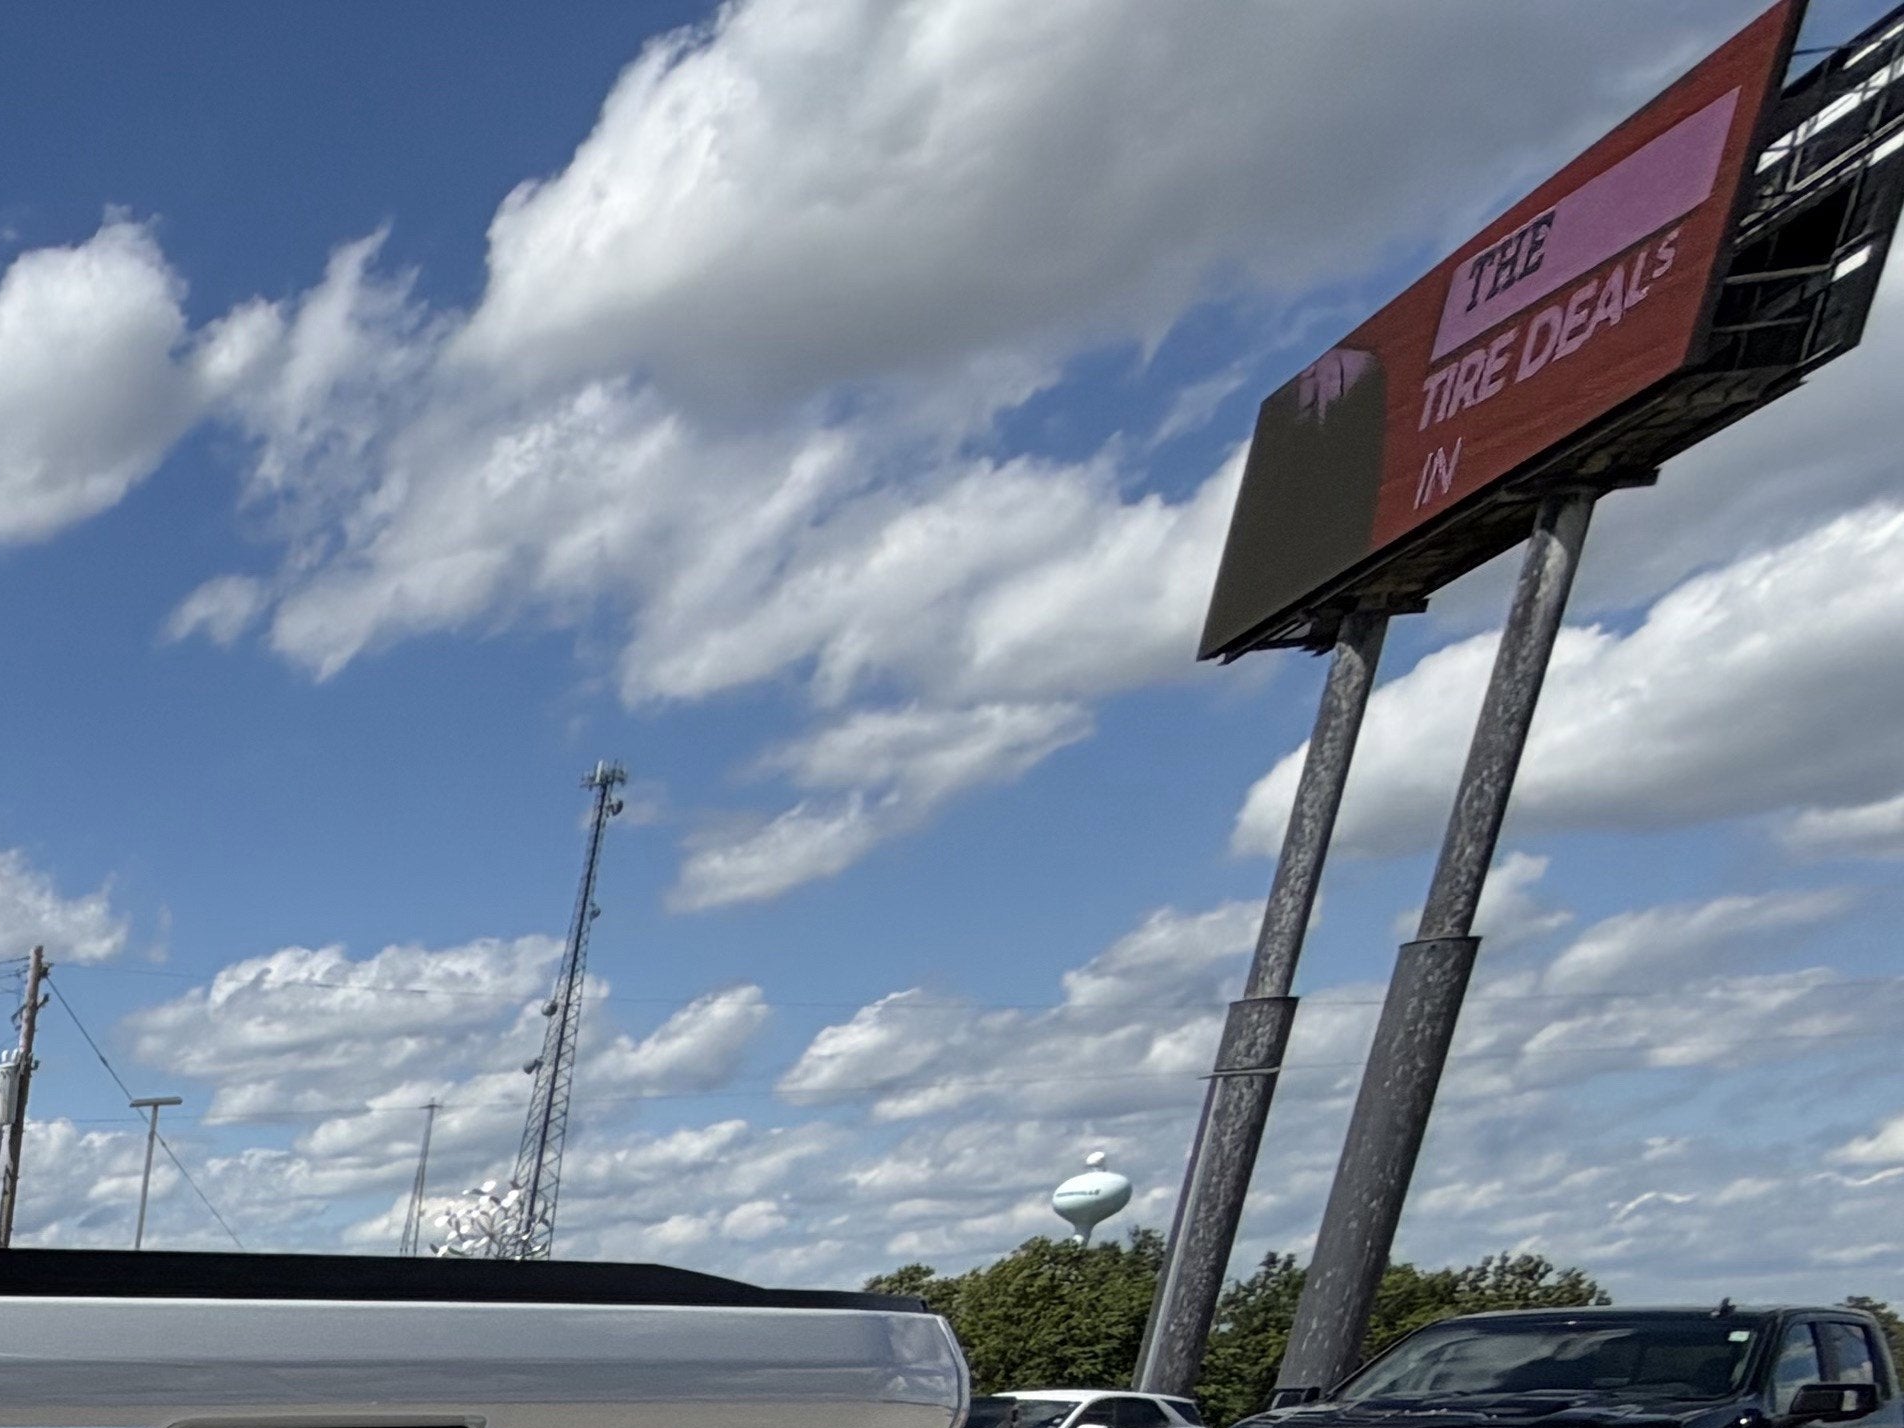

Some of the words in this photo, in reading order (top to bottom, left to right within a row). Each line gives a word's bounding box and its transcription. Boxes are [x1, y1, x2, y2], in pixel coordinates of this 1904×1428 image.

[1466, 209, 1556, 313] THE
[1417, 333, 1516, 431] TIRE
[1413, 437, 1462, 510] IN
